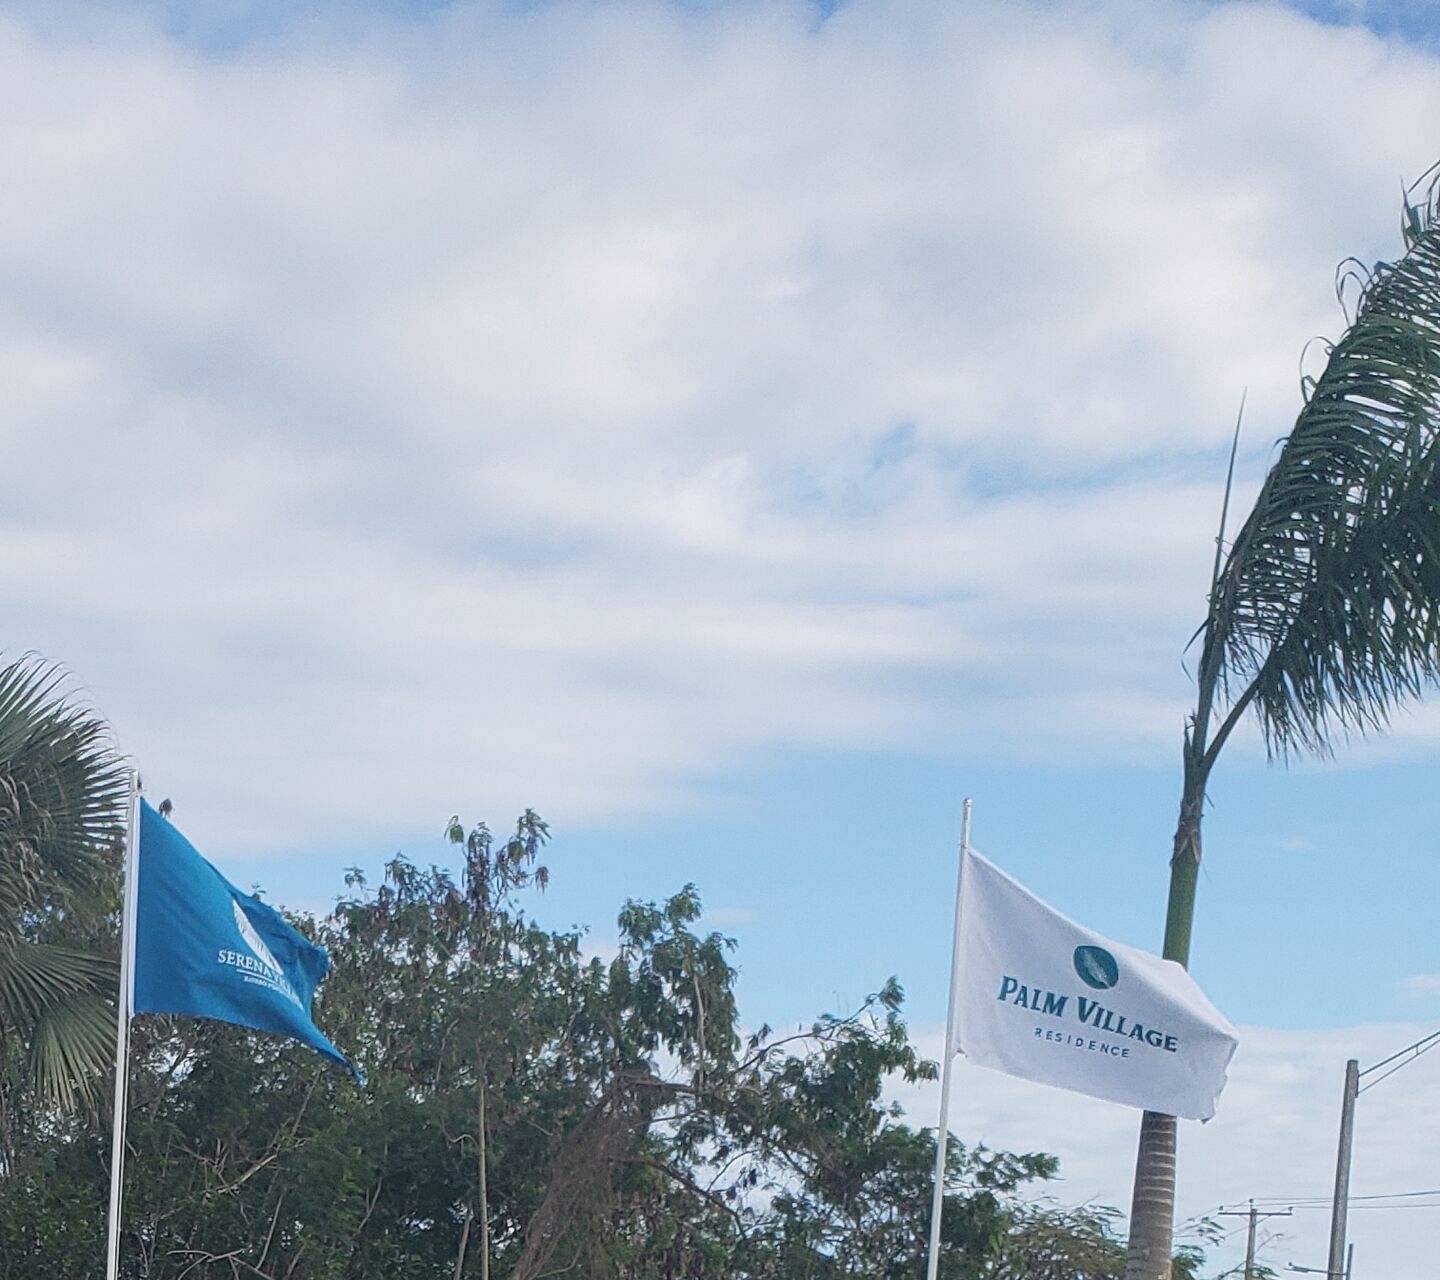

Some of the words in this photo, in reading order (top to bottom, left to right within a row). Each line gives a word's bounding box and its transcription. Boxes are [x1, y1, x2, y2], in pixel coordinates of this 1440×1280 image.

[218, 949, 272, 978] SERENA
[997, 975, 1069, 1018] PALM
[1077, 996, 1178, 1053] VILLAGE
[1034, 1027, 1130, 1058] RESIDENCE
